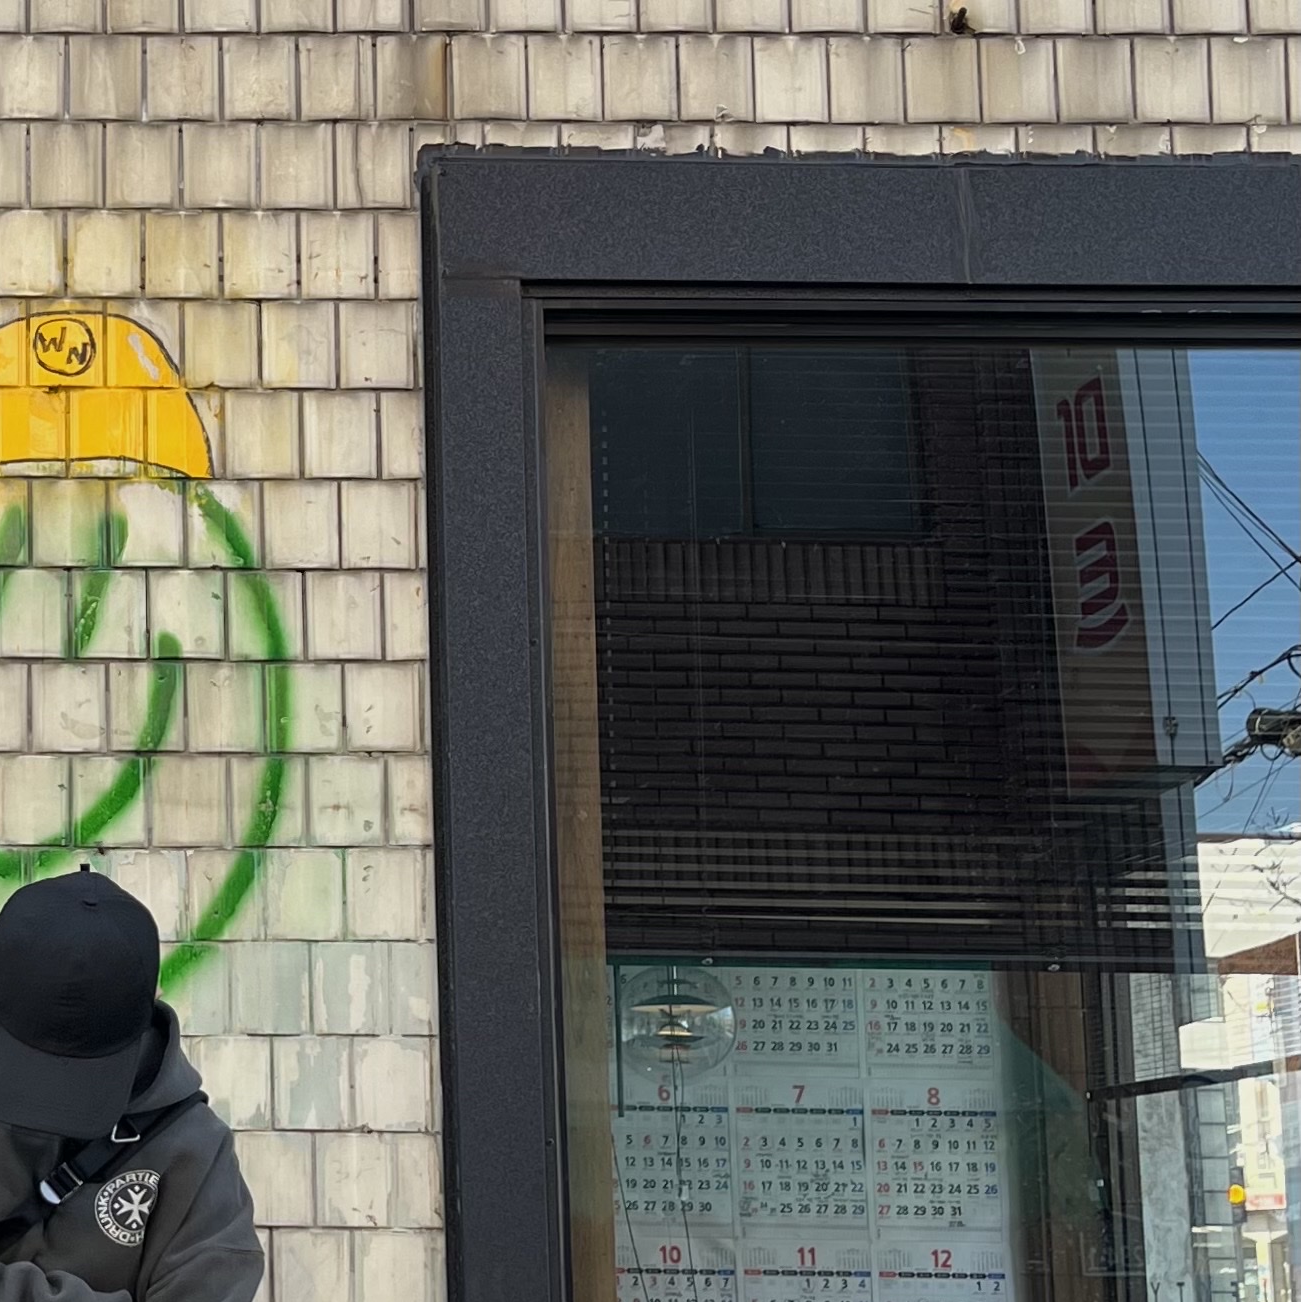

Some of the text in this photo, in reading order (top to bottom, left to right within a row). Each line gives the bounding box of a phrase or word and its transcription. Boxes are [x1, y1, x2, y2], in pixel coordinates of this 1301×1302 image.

[37, 326, 91, 366] WN
[736, 976, 852, 987] 5 6 7 8 9 10 11
[870, 978, 984, 989] 2 3 4 5 6 7 8
[735, 998, 853, 1008] 12 13 14 15 16 17 18
[871, 1000, 987, 1011] 9 10 11 12 13 14 15
[658, 1085, 670, 1101] 6
[793, 1085, 804, 1103] 7
[928, 1088, 940, 1105] 8
[699, 1115, 704, 1124] 2
[716, 1115, 722, 1124] 3
[853, 1118, 856, 1126] 1
[916, 1119, 991, 1128] 1 2 3 4 5
[626, 1135, 726, 1146] 5 6 7 8 9 10
[743, 1137, 858, 1148] 2 3 4 5 6 7 8
[879, 1139, 994, 1150] 6 7 8 9 10 11 12
[744, 1159, 862, 1170] 9 10 11 12 13 14 15
[877, 1161, 996, 1172] 13 14 15 16 17 18 19
[97, 1195, 130, 1244] DRUNK
[659, 1246, 681, 1263] 10
[797, 1247, 816, 1265] 11
[931, 1249, 952, 1268] 12
[633, 1276, 638, 1285] 2
[651, 1277, 657, 1285] 3
[669, 1277, 675, 1286] 4
[705, 1278, 711, 1287] 6
[723, 1278, 729, 1287] 7
[806, 1279, 866, 1288] 1 2 3 4
[977, 1282, 1000, 1291] 1 2
